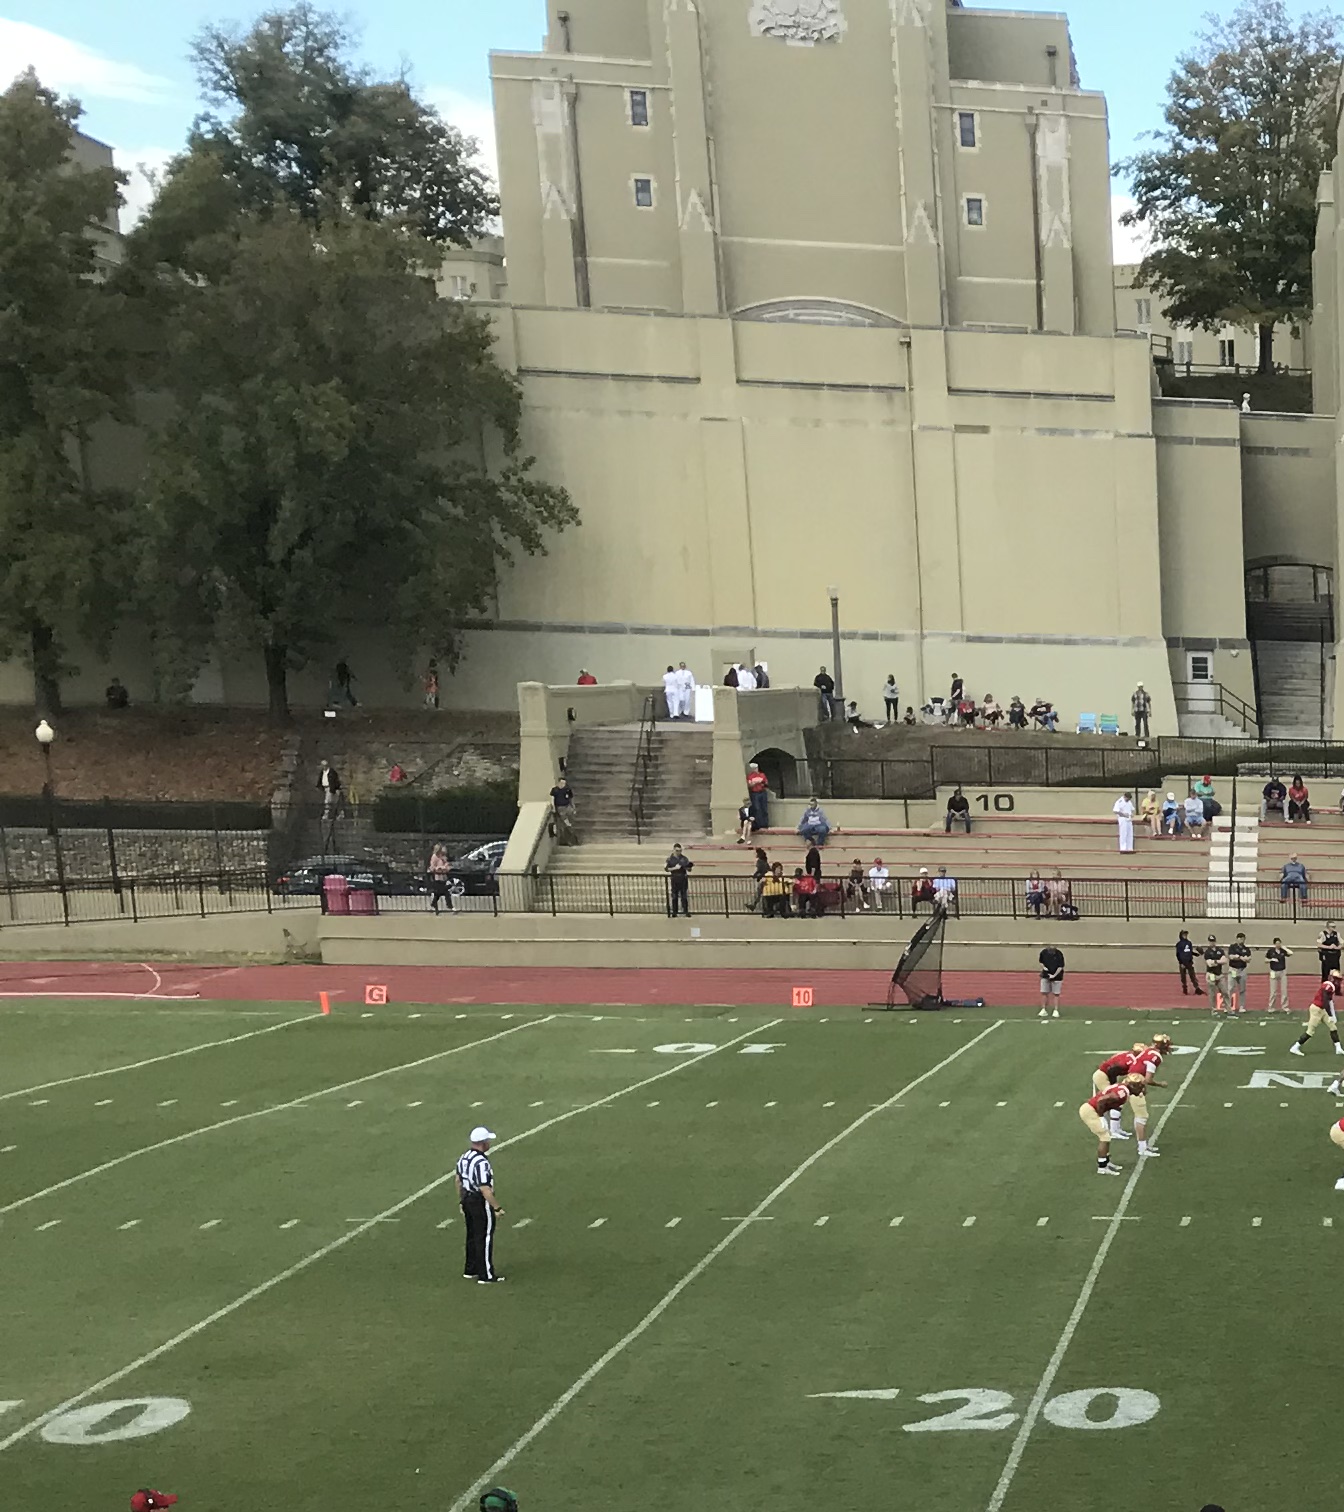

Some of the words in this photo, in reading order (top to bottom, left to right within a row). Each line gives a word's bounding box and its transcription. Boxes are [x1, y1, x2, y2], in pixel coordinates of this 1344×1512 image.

[975, 793, 1015, 812] 10
[368, 986, 384, 1002] G
[795, 989, 810, 1005] 10
[901, 1385, 1163, 1433] 20
